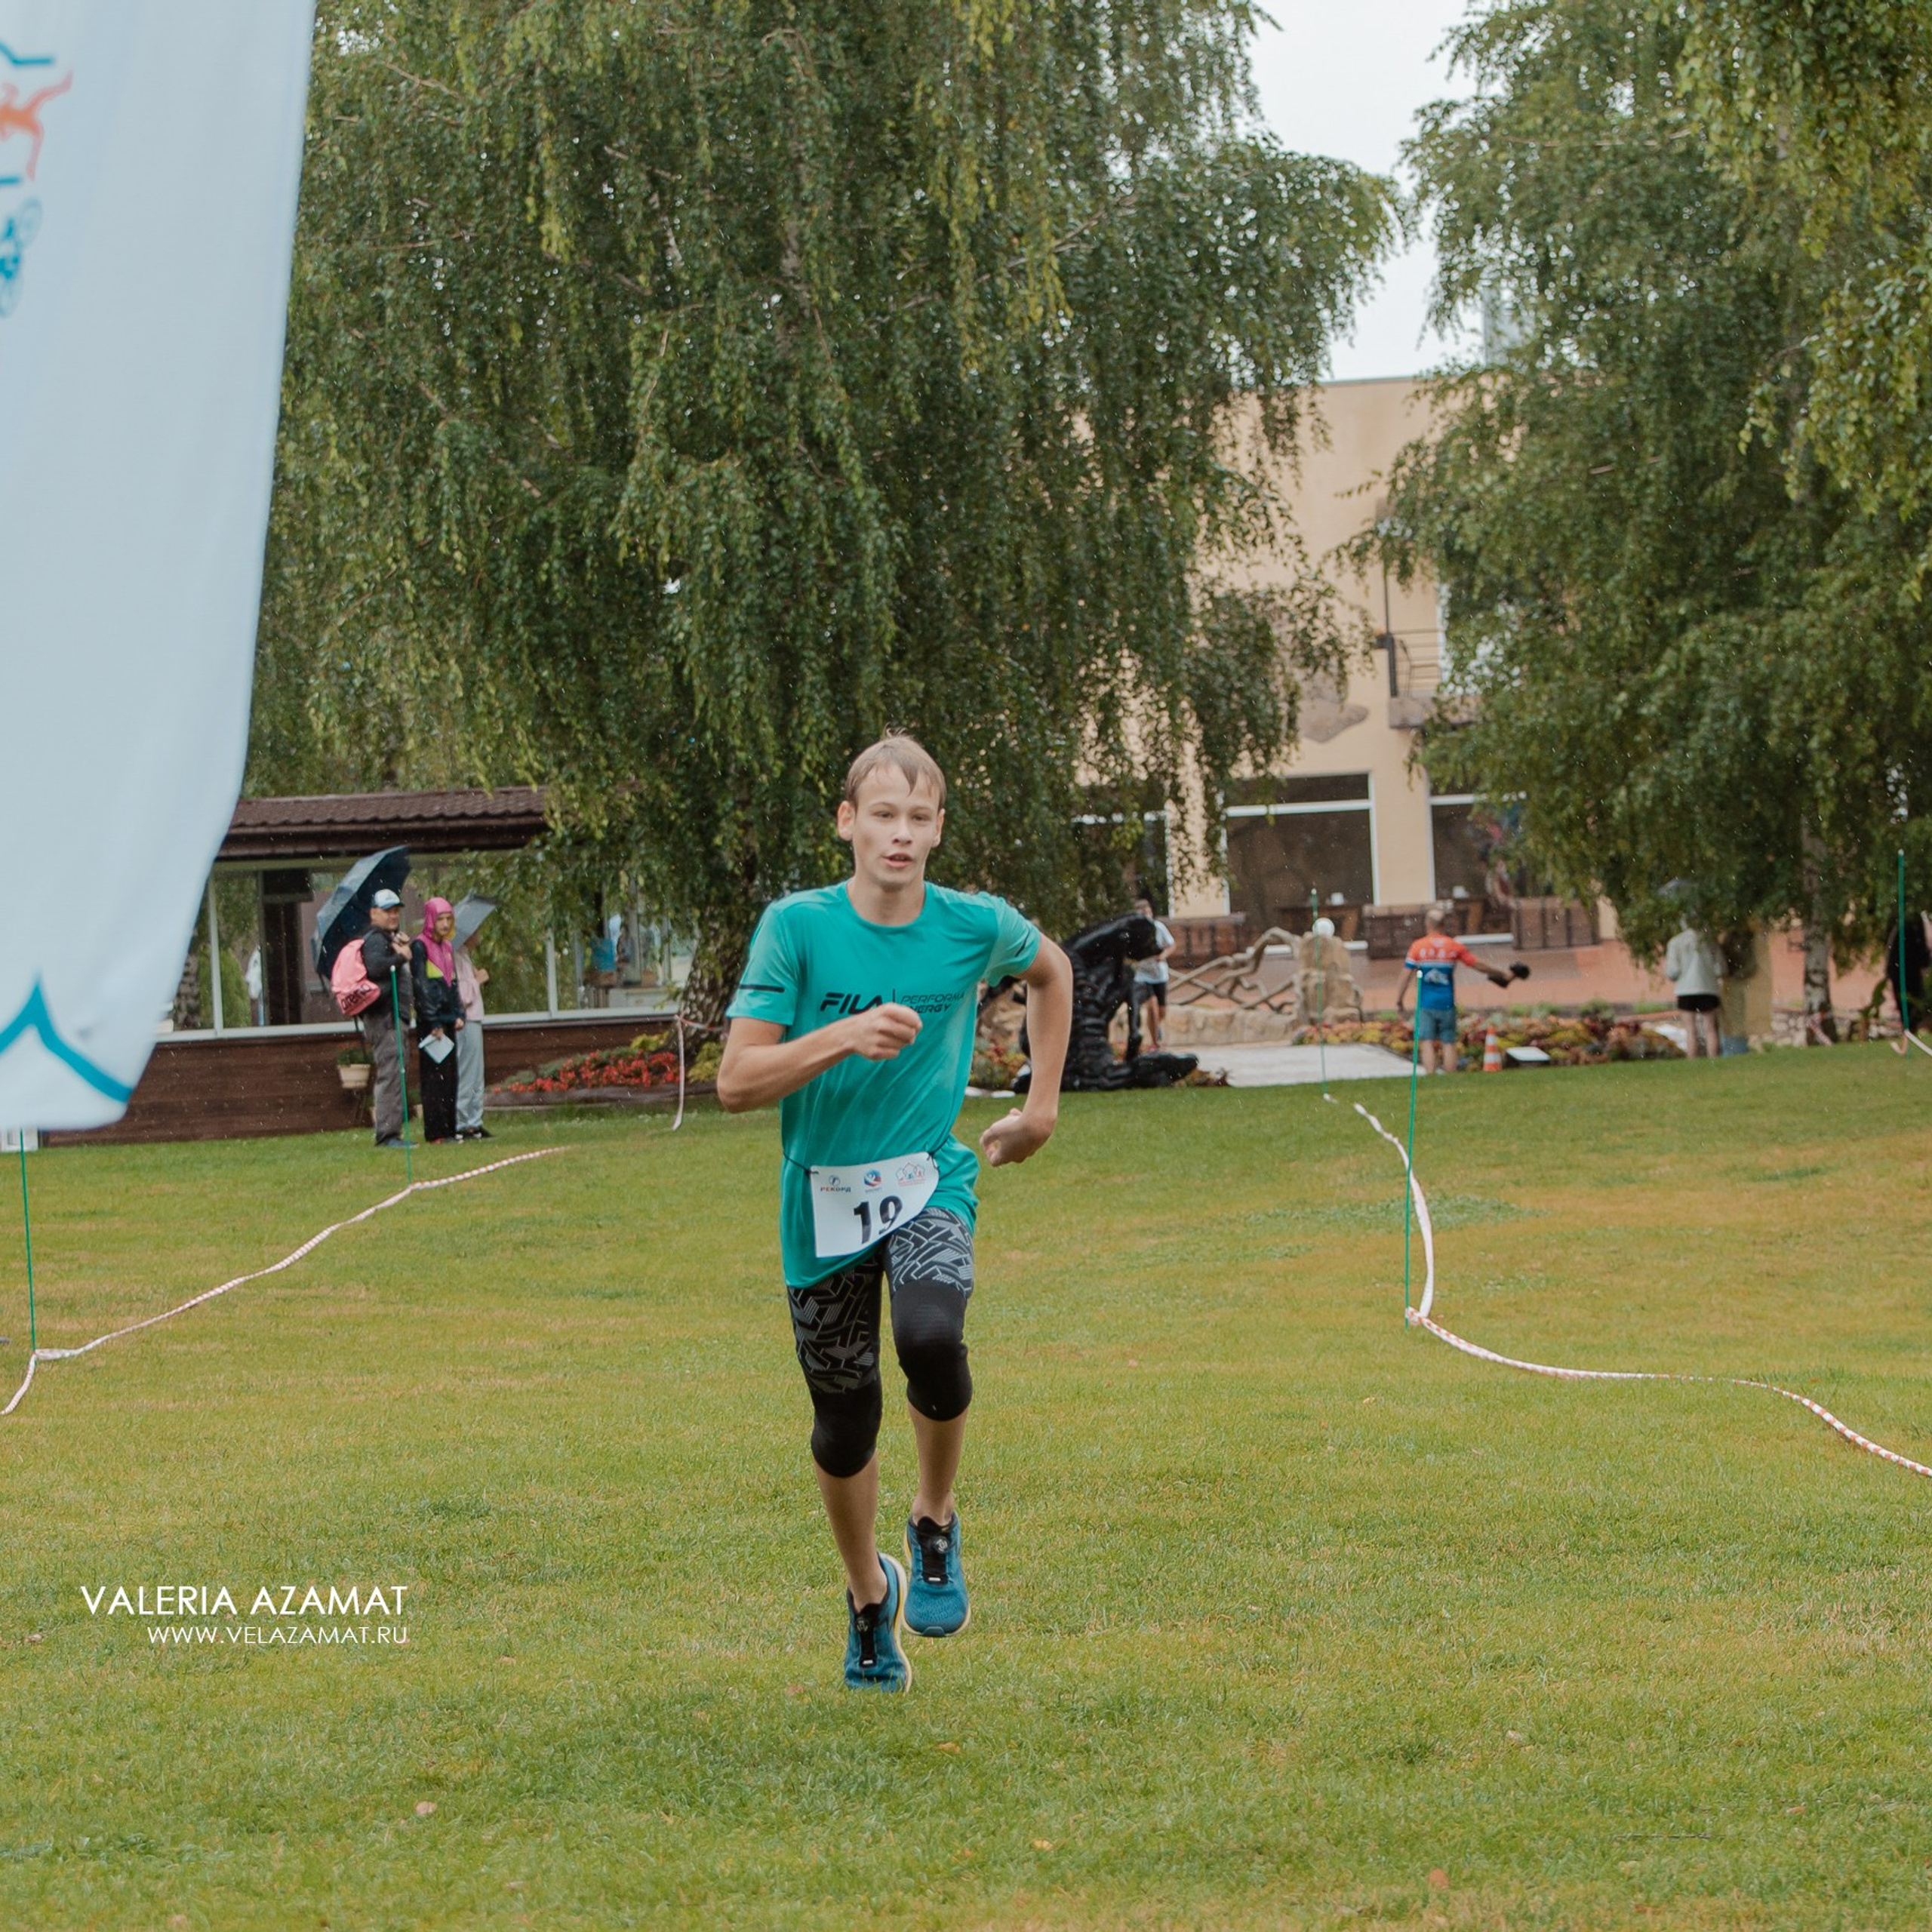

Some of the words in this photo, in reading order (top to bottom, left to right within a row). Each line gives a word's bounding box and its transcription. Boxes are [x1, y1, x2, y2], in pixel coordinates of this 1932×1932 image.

[820, 992, 883, 1014] FILA
[909, 1003, 952, 1014] NERGY
[854, 1195, 903, 1244] 19
